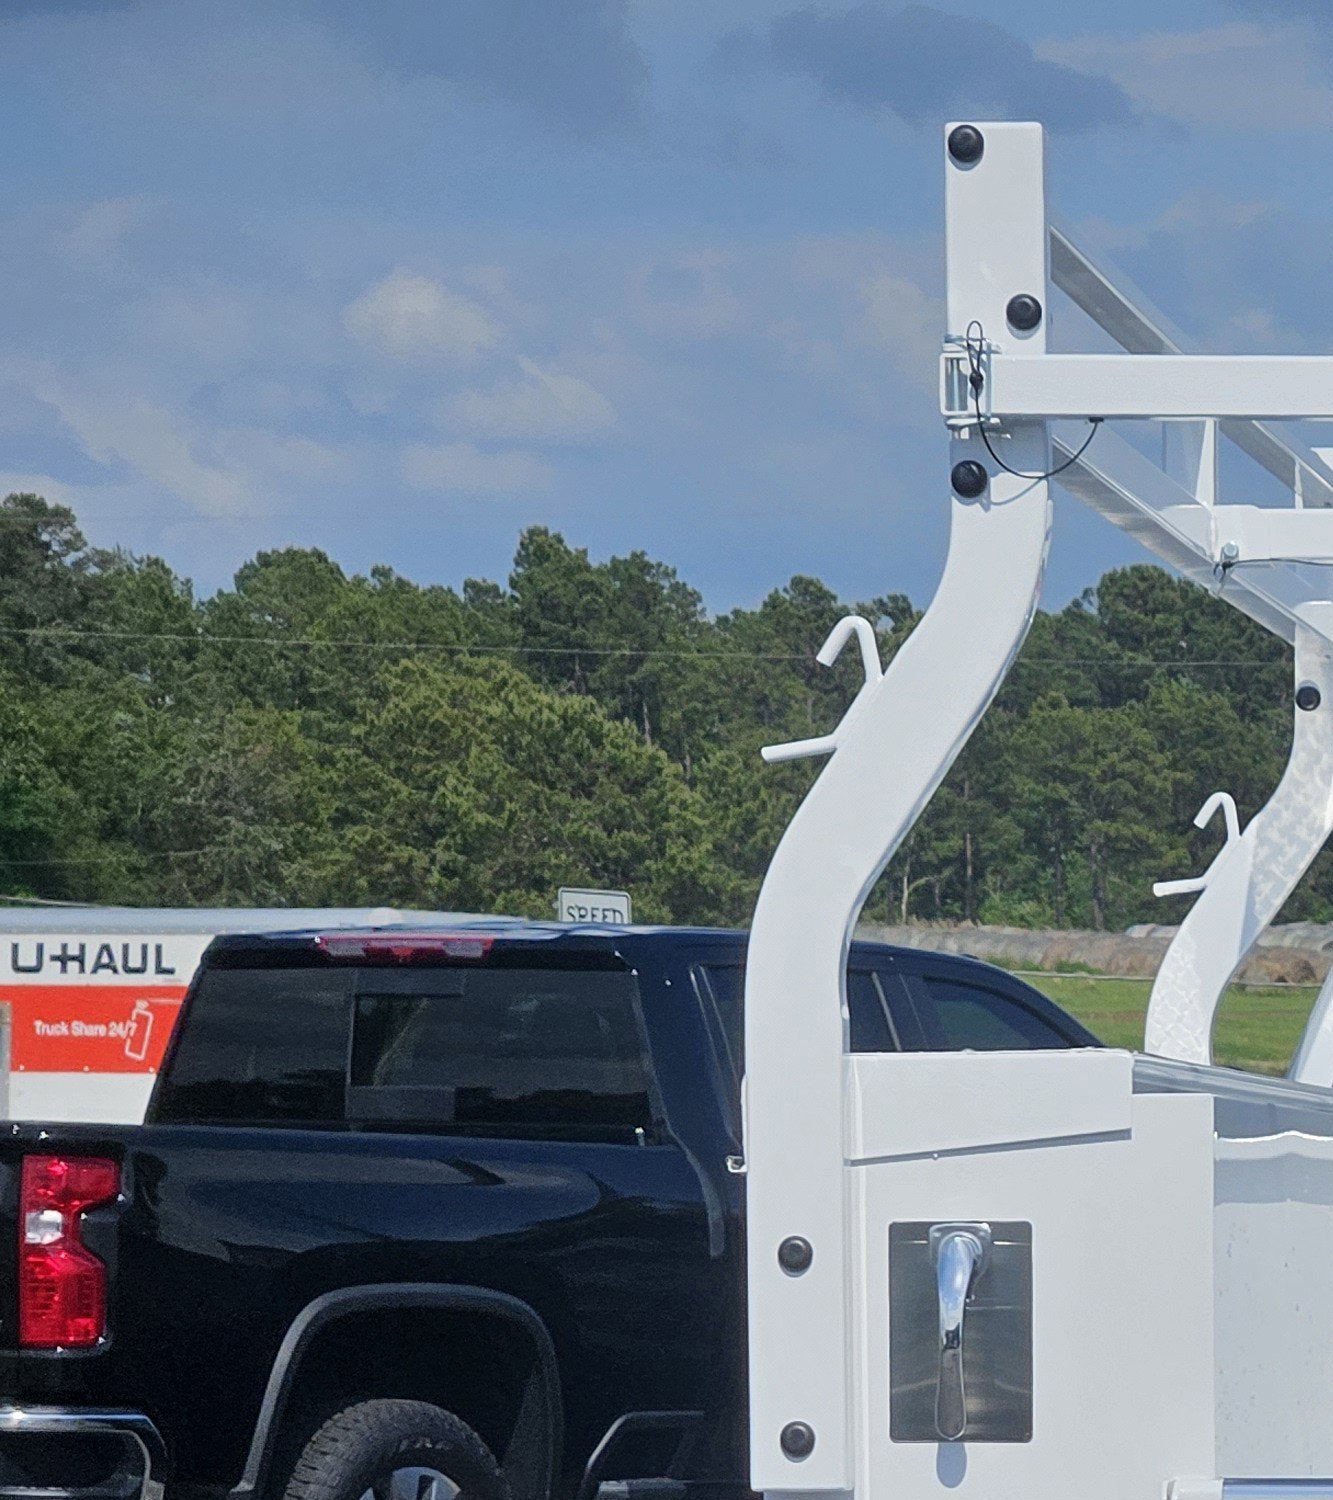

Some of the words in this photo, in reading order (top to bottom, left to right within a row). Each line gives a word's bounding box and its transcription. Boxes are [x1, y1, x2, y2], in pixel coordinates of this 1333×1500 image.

[11, 942, 176, 975] U-HAUL
[34, 1020, 69, 1037] Truck
[71, 1020, 107, 1038] Share
